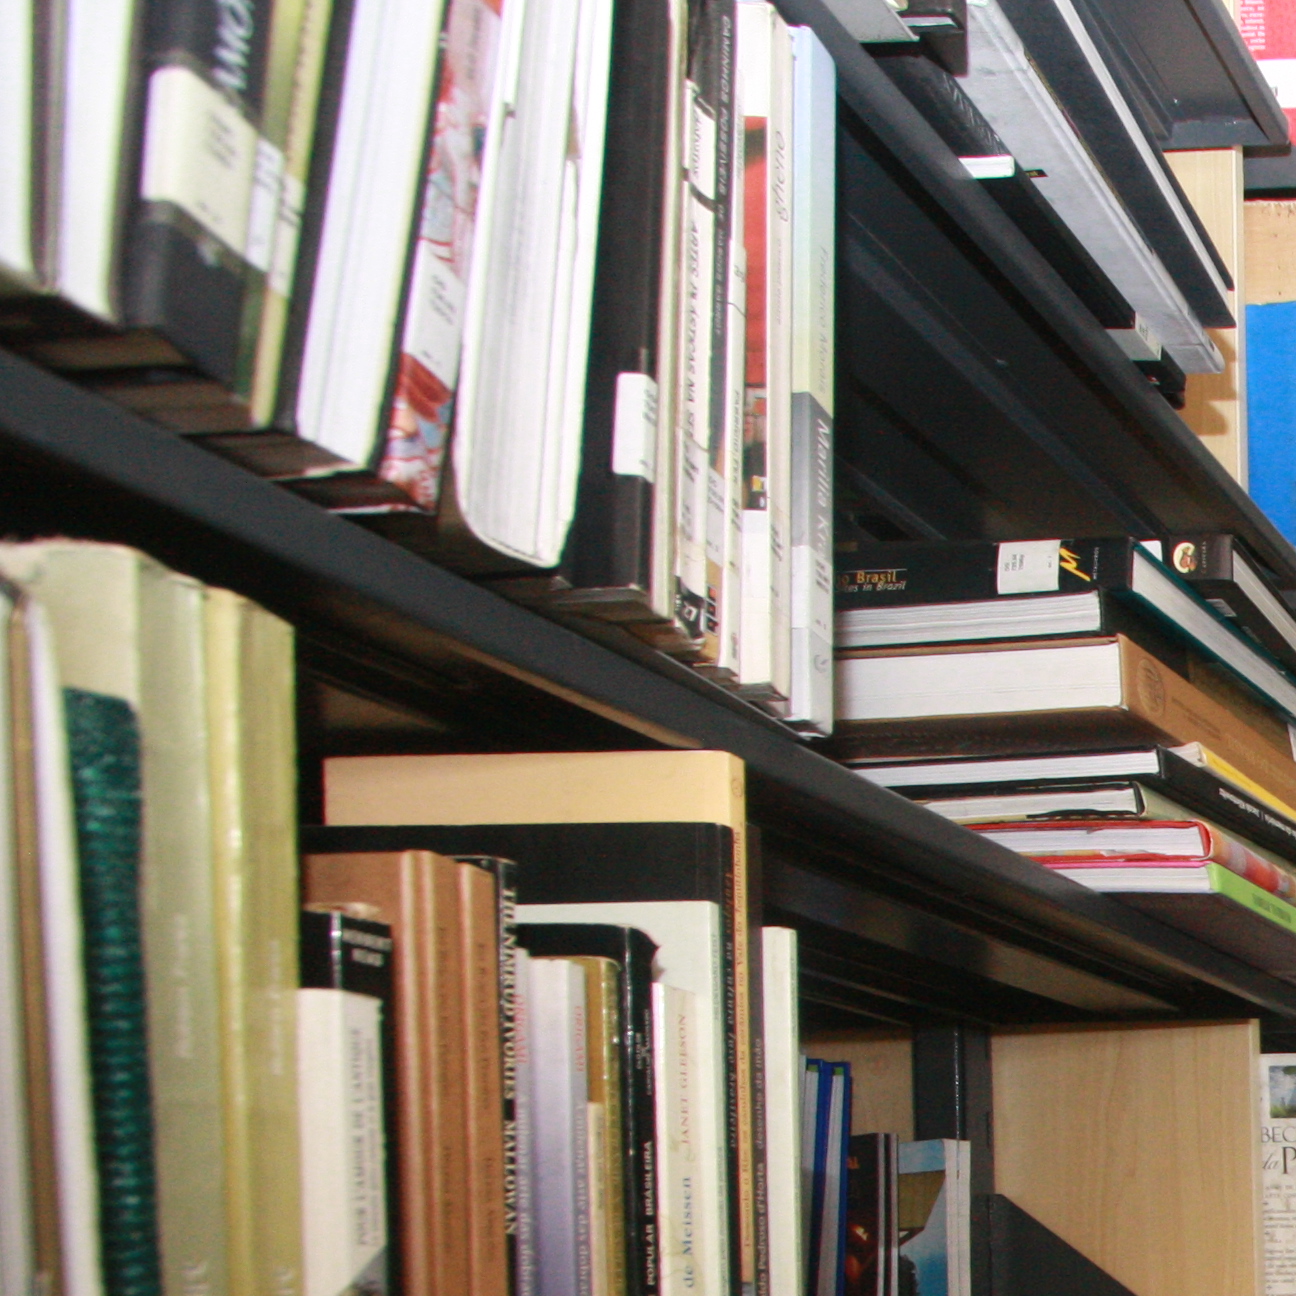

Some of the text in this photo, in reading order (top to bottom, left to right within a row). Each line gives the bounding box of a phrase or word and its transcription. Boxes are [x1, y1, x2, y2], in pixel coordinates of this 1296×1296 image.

[720, 15, 732, 105] CAMINHOS
[819, 246, 830, 329] Frederico
[856, 570, 898, 584] Brasil
[876, 580, 908, 592] Brazil
[502, 1119, 517, 1237] MALLOWAN
[643, 1141, 656, 1216] BRASILEIRA
[677, 1013, 694, 1290] de Meissen JANET GLEESON
[755, 1162, 766, 1214] d'Horta
[645, 1223, 656, 1288] POPULAR
[757, 1217, 768, 1271] Pedroso
